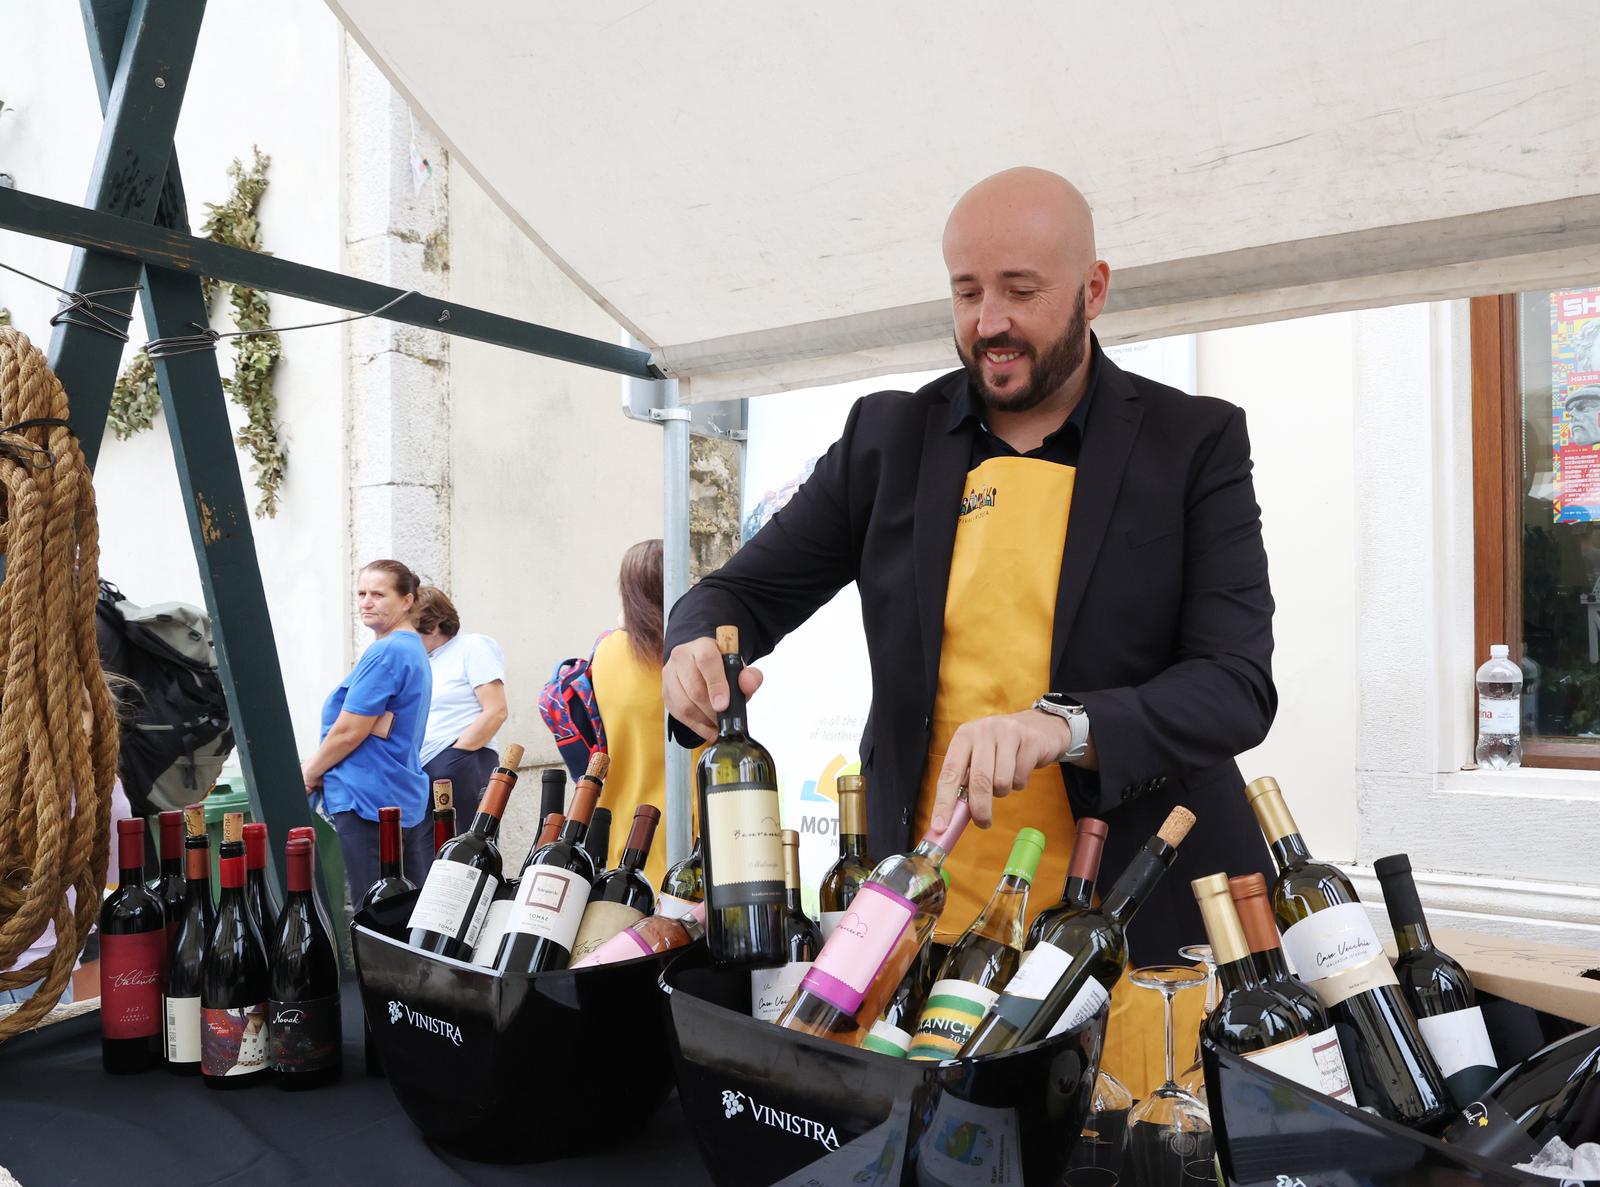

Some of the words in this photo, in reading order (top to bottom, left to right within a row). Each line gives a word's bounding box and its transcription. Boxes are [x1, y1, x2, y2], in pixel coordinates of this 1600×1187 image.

[842, 714, 857, 727] the
[800, 816, 839, 836] MOT
[272, 1009, 304, 1025] Novak
[404, 1004, 464, 1047] VINISTRA
[950, 1034, 967, 1045] 202
[748, 1096, 841, 1153] VINISTRA
